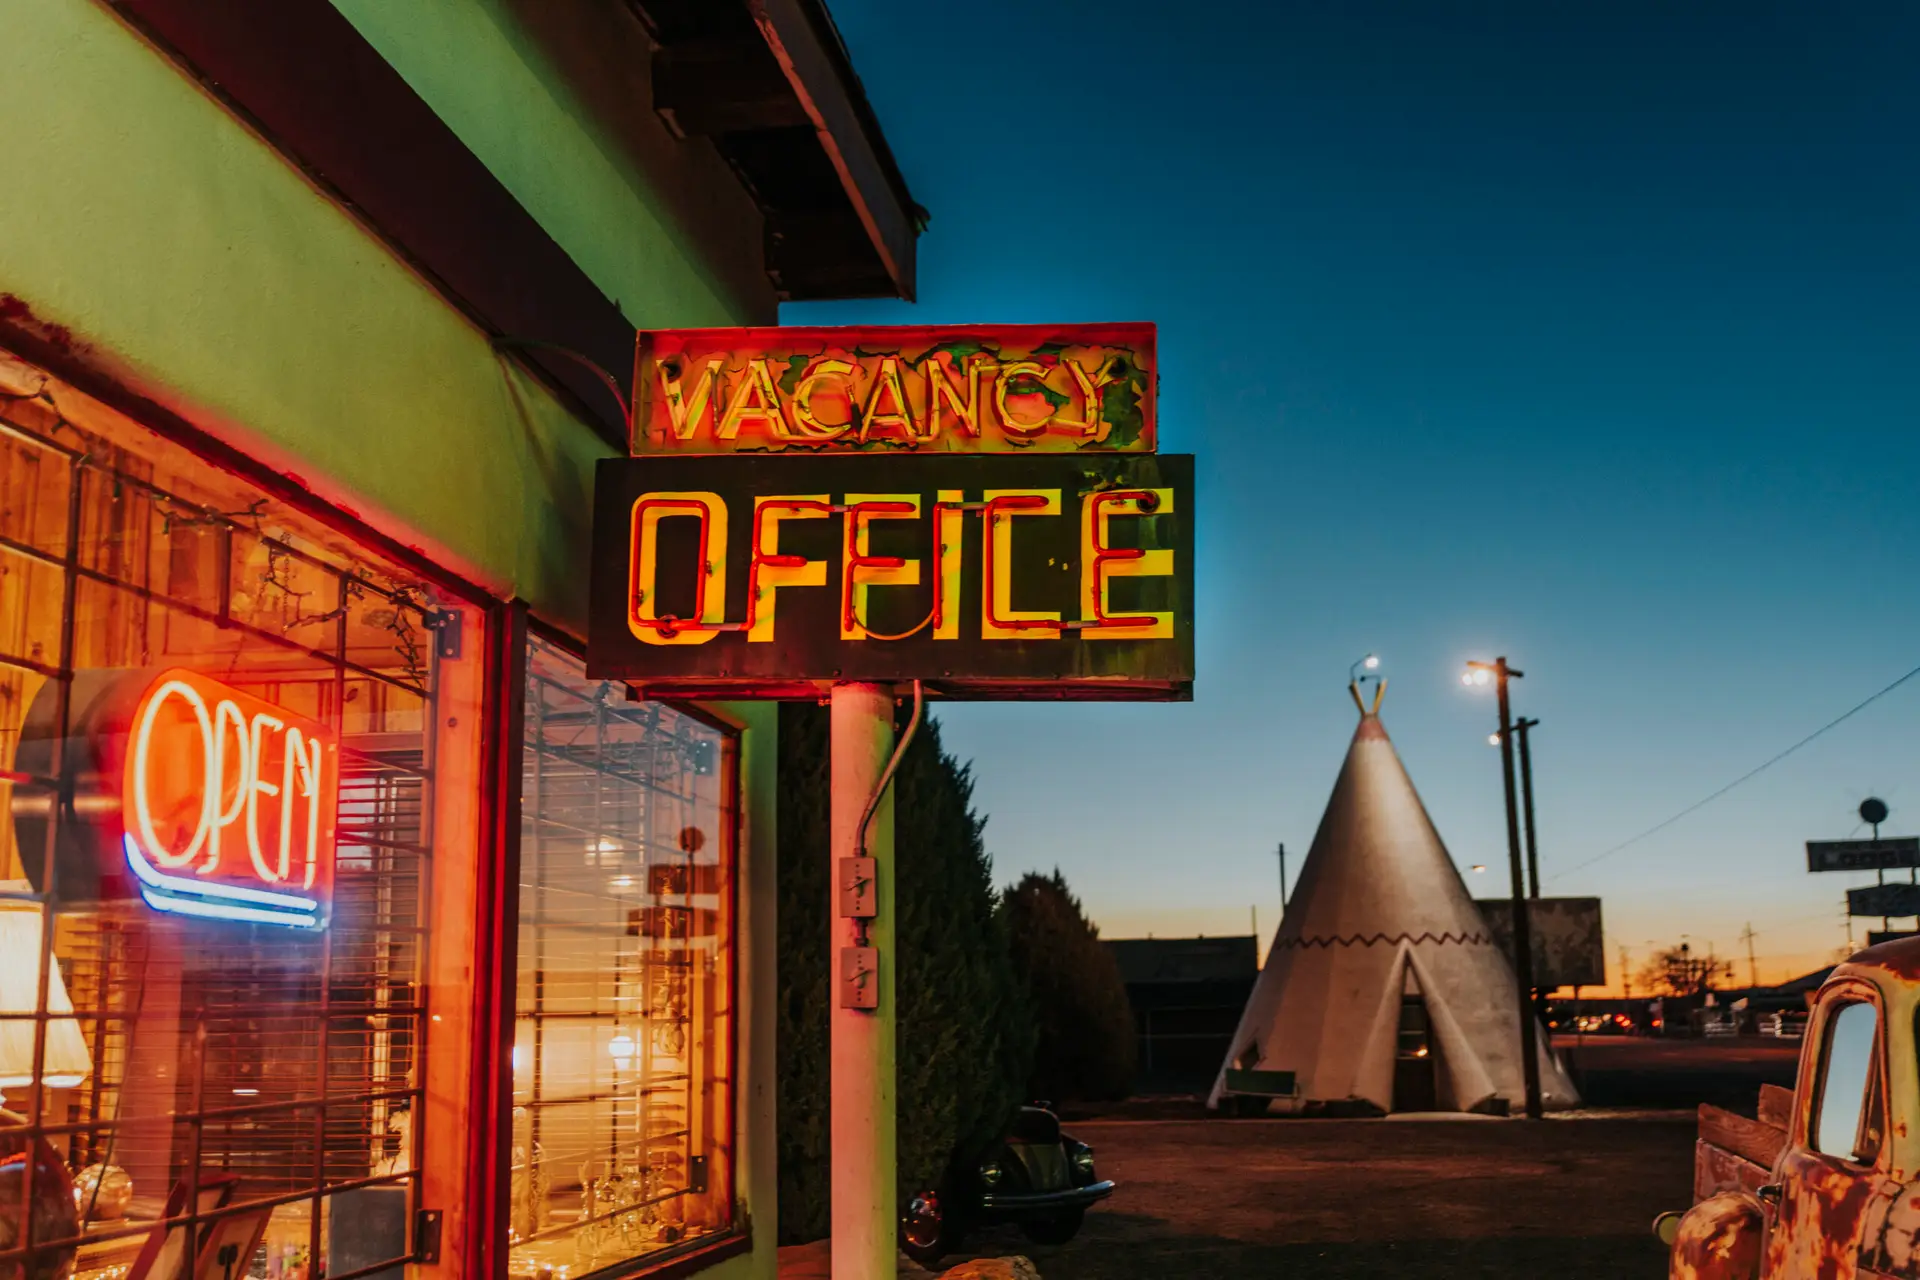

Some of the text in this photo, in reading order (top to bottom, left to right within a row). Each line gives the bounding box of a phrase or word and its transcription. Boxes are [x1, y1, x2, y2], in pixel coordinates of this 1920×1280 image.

[655, 357, 1117, 442] VACANCY
[627, 487, 1174, 646] OFFICE
[134, 680, 321, 890] OPEN
